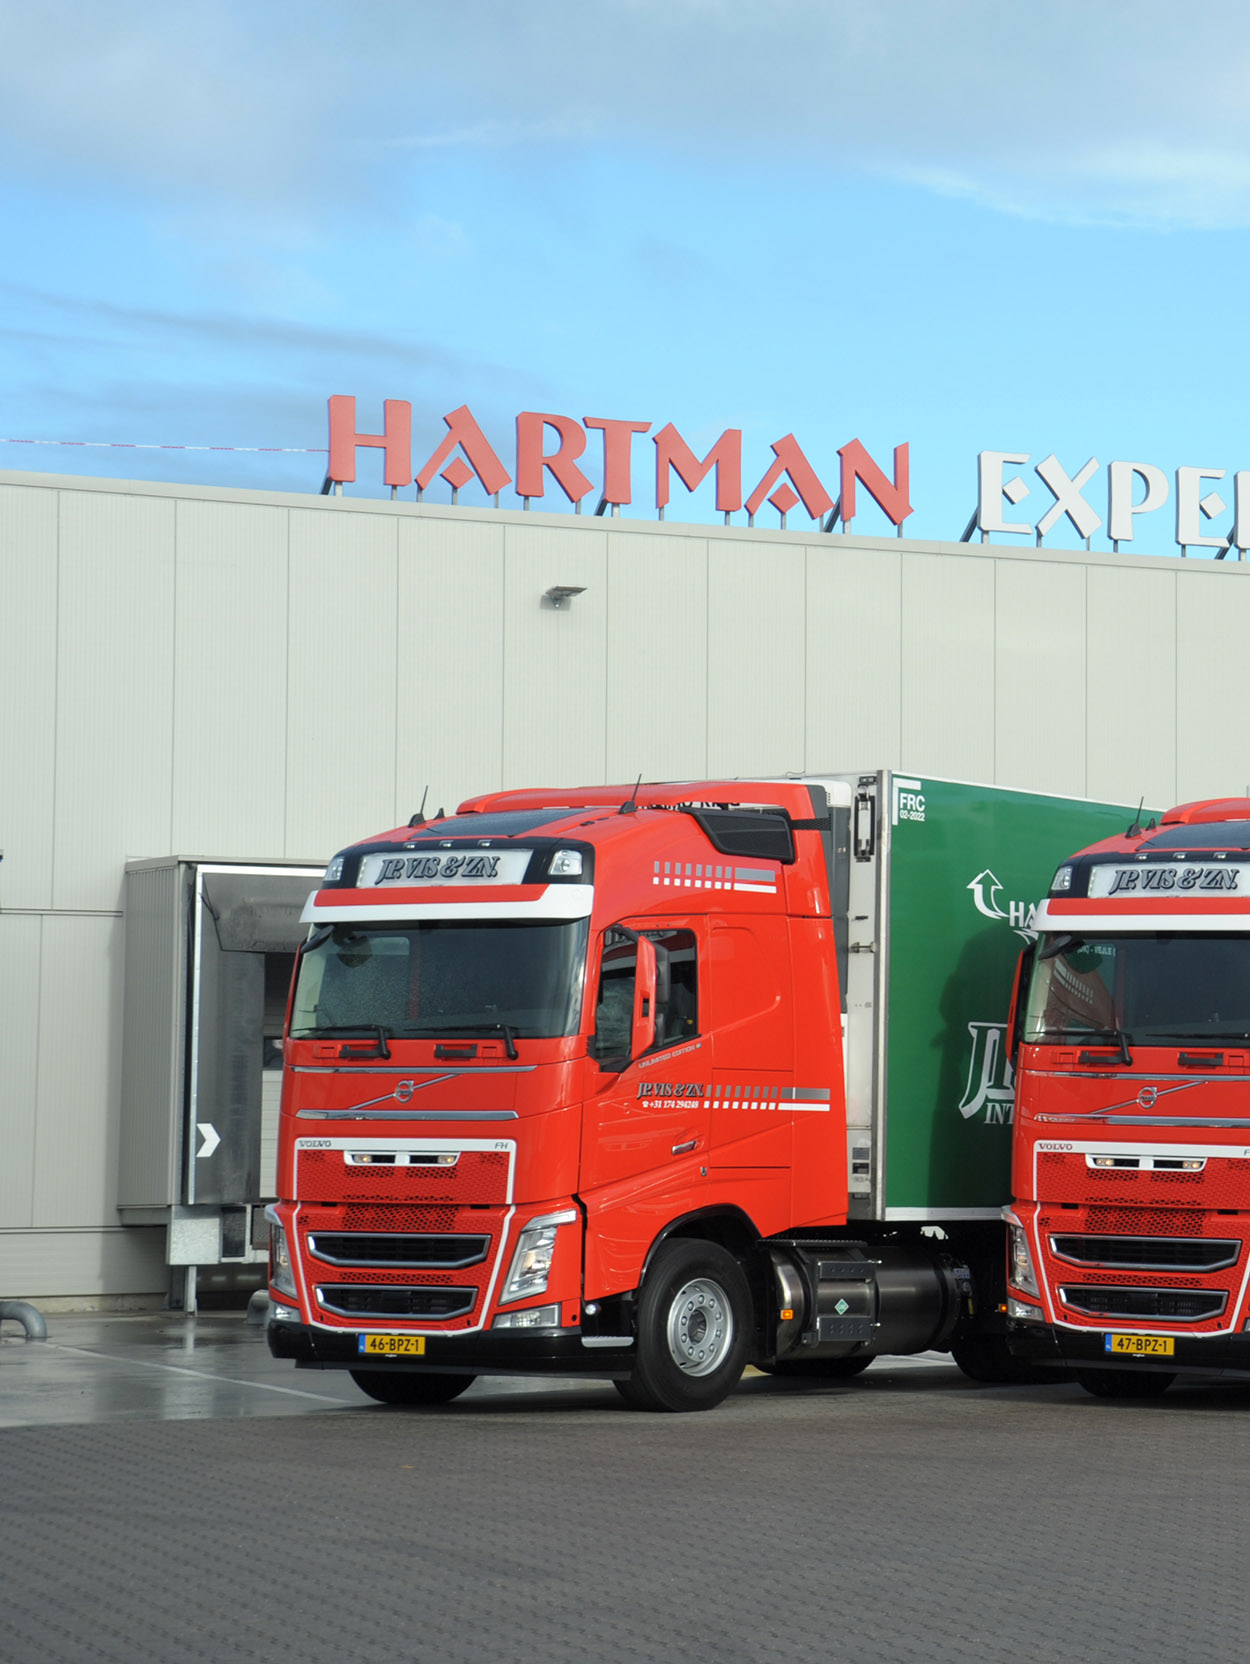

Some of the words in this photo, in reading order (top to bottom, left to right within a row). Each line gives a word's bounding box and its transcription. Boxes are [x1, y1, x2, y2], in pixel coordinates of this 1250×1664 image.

[328, 394, 914, 526] HARTMAN
[900, 792, 925, 811] FRC
[899, 809, 926, 822] 02-2022
[406, 856, 441, 878] VIS
[440, 855, 466, 878] &
[461, 856, 501, 877] ZN.
[1140, 868, 1177, 889] VIS
[1177, 867, 1204, 890] &
[1199, 868, 1240, 890] ZN.
[653, 1083, 673, 1097] VIS
[673, 1083, 686, 1098] &
[299, 1140, 332, 1148] VOLVO
[495, 1141, 508, 1149] FH
[1038, 1142, 1073, 1150] VOLVO
[370, 1337, 419, 1352] 46-BPZ-1
[1117, 1337, 1167, 1353] 47-BPZ-1
